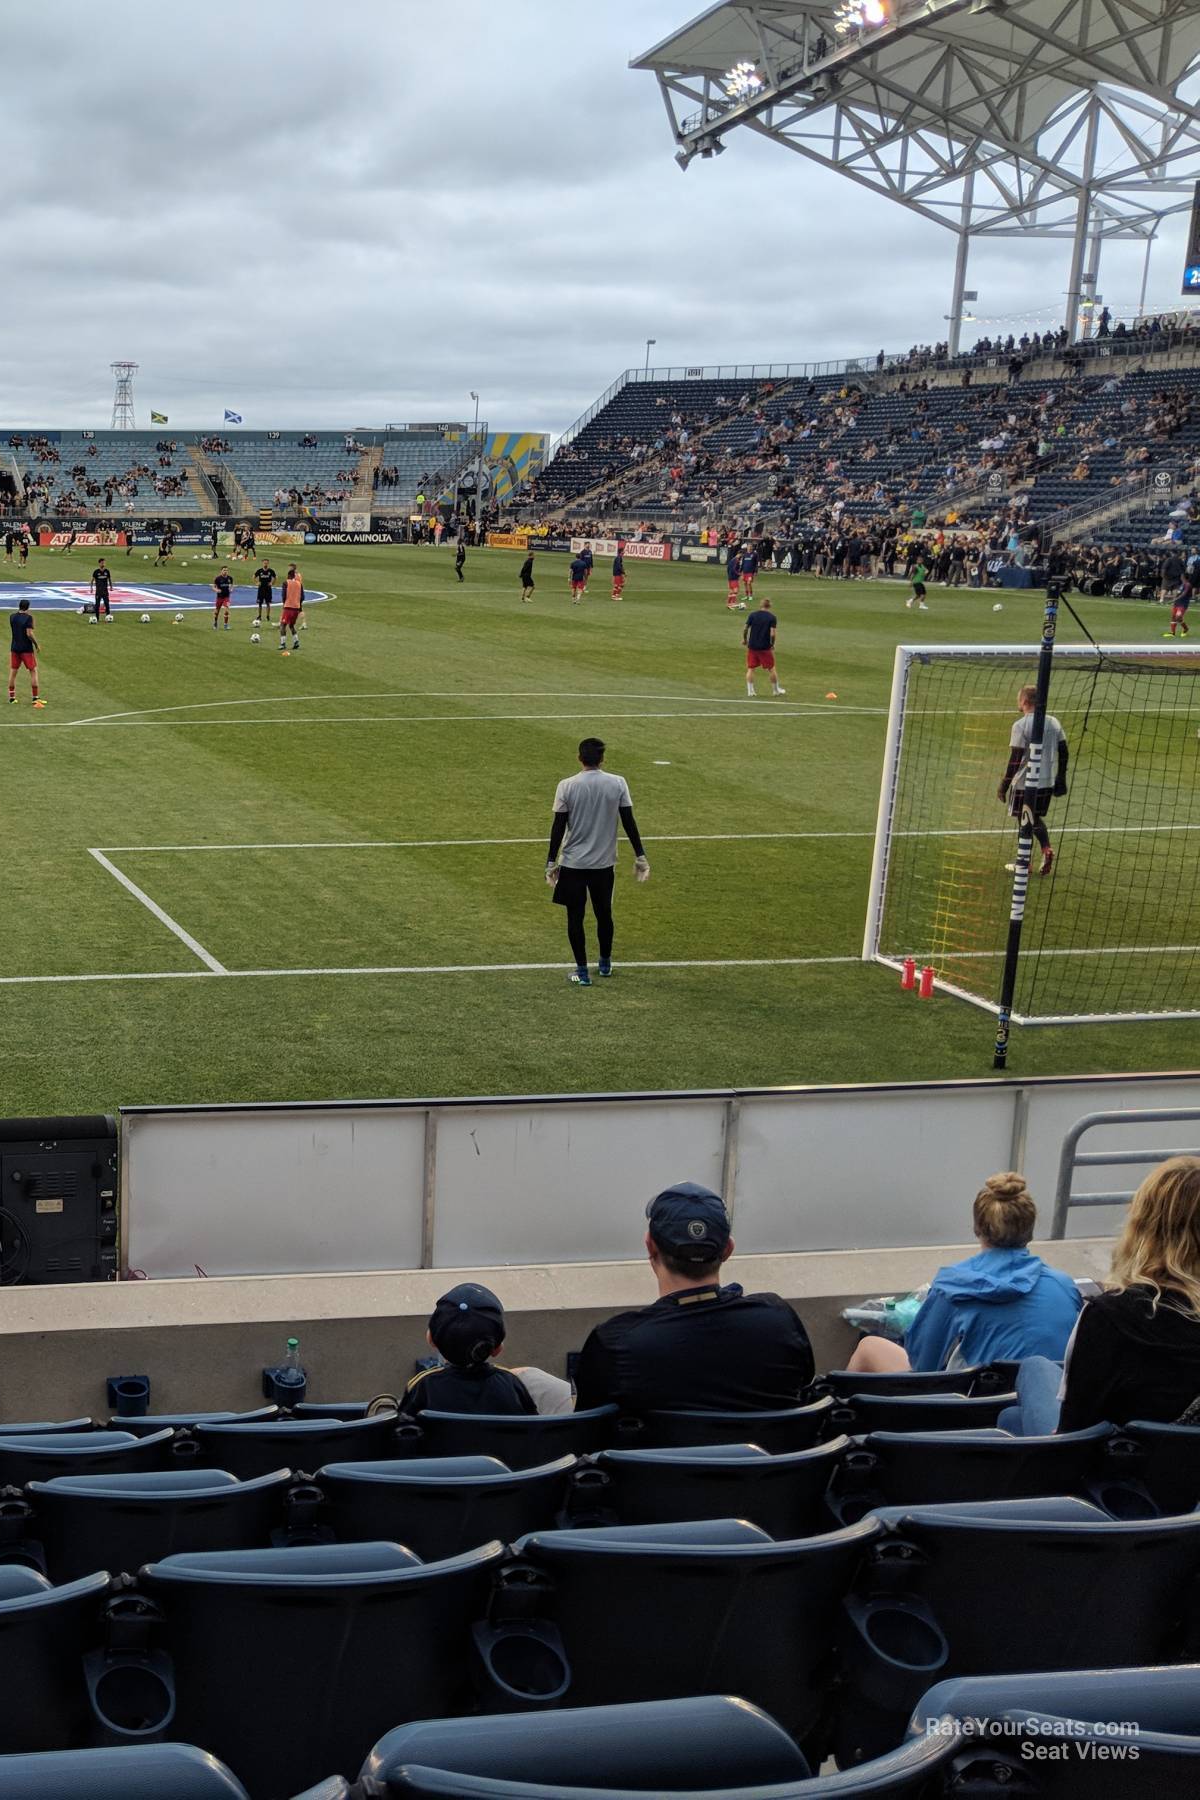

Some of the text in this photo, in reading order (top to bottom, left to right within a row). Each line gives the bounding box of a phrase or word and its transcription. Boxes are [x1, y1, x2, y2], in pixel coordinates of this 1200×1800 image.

[317, 534, 393, 542] KONICA MINOLTA
[624, 542, 664, 558] ADVOCARE
